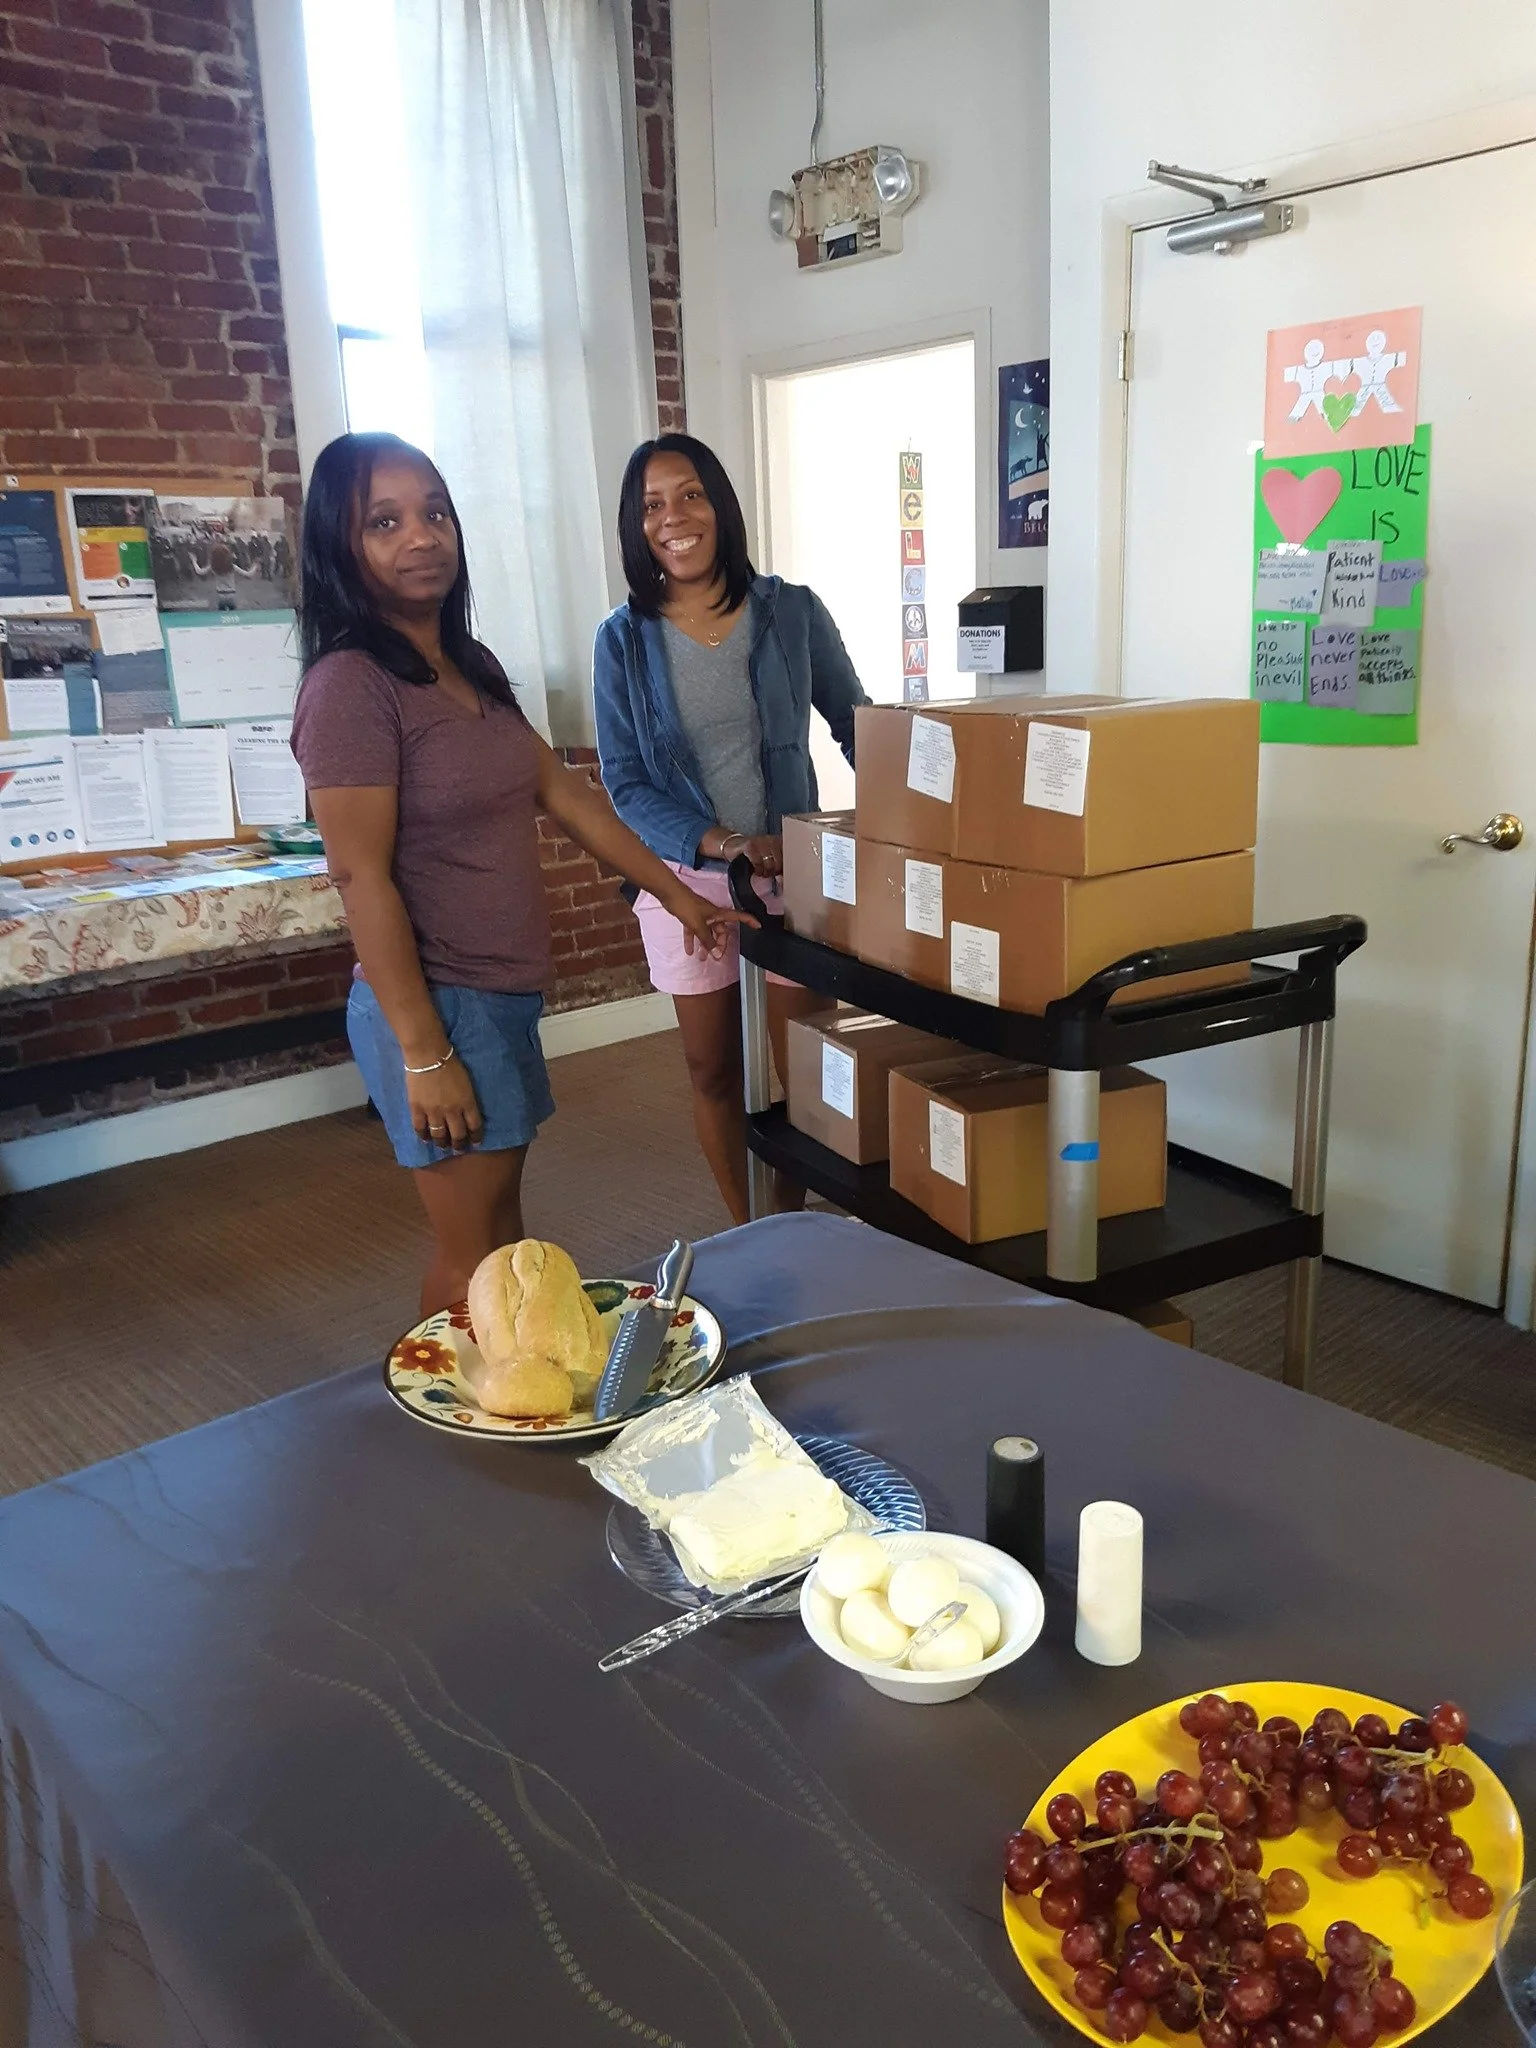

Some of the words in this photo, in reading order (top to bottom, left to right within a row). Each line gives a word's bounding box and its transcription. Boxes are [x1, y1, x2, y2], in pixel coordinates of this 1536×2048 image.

[1351, 444, 1427, 495] LOVE
[1371, 510, 1399, 544] IS
[1327, 551, 1375, 573] Patient
[1332, 587, 1366, 609] Kind
[960, 629, 1001, 638] DONATIONS
[1312, 629, 1355, 646] Love
[1257, 641, 1278, 651] no
[1311, 650, 1356, 667] never
